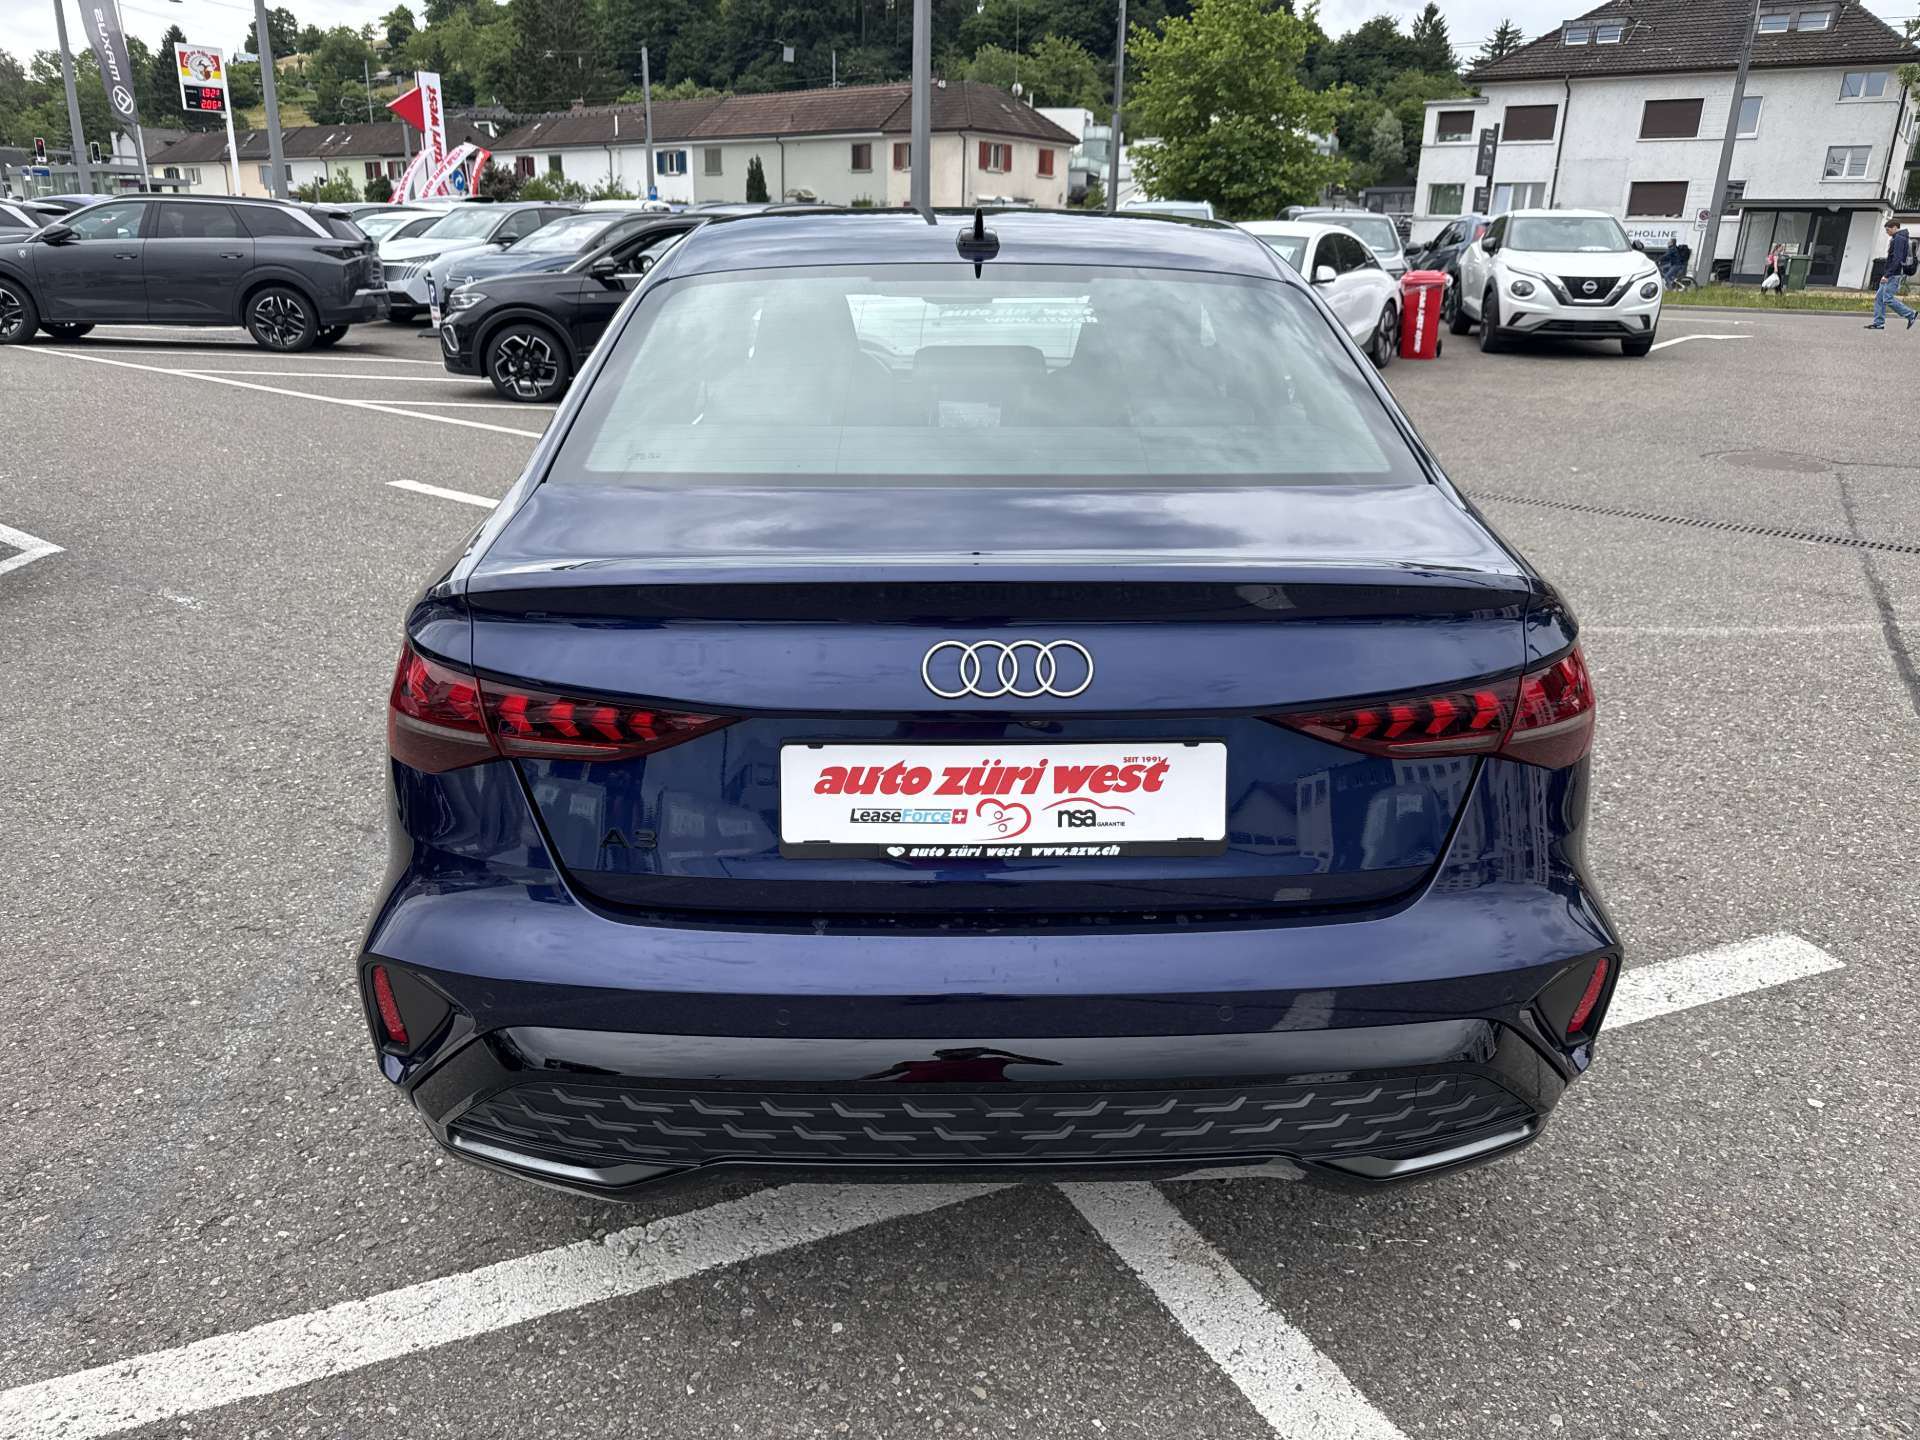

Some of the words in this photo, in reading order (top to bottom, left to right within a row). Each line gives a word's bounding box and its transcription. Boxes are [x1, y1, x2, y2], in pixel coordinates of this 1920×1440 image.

[814, 760, 933, 796] auto
[933, 758, 1049, 796] züri
[1053, 757, 1170, 794] west
[850, 808, 952, 823] LeaseForce
[1057, 809, 1096, 828] nsa
[600, 827, 658, 849] A3
[909, 846, 945, 857] auto
[948, 845, 984, 857] züri
[986, 846, 1022, 857] west
[1031, 844, 1121, 857] www.azw.ch
